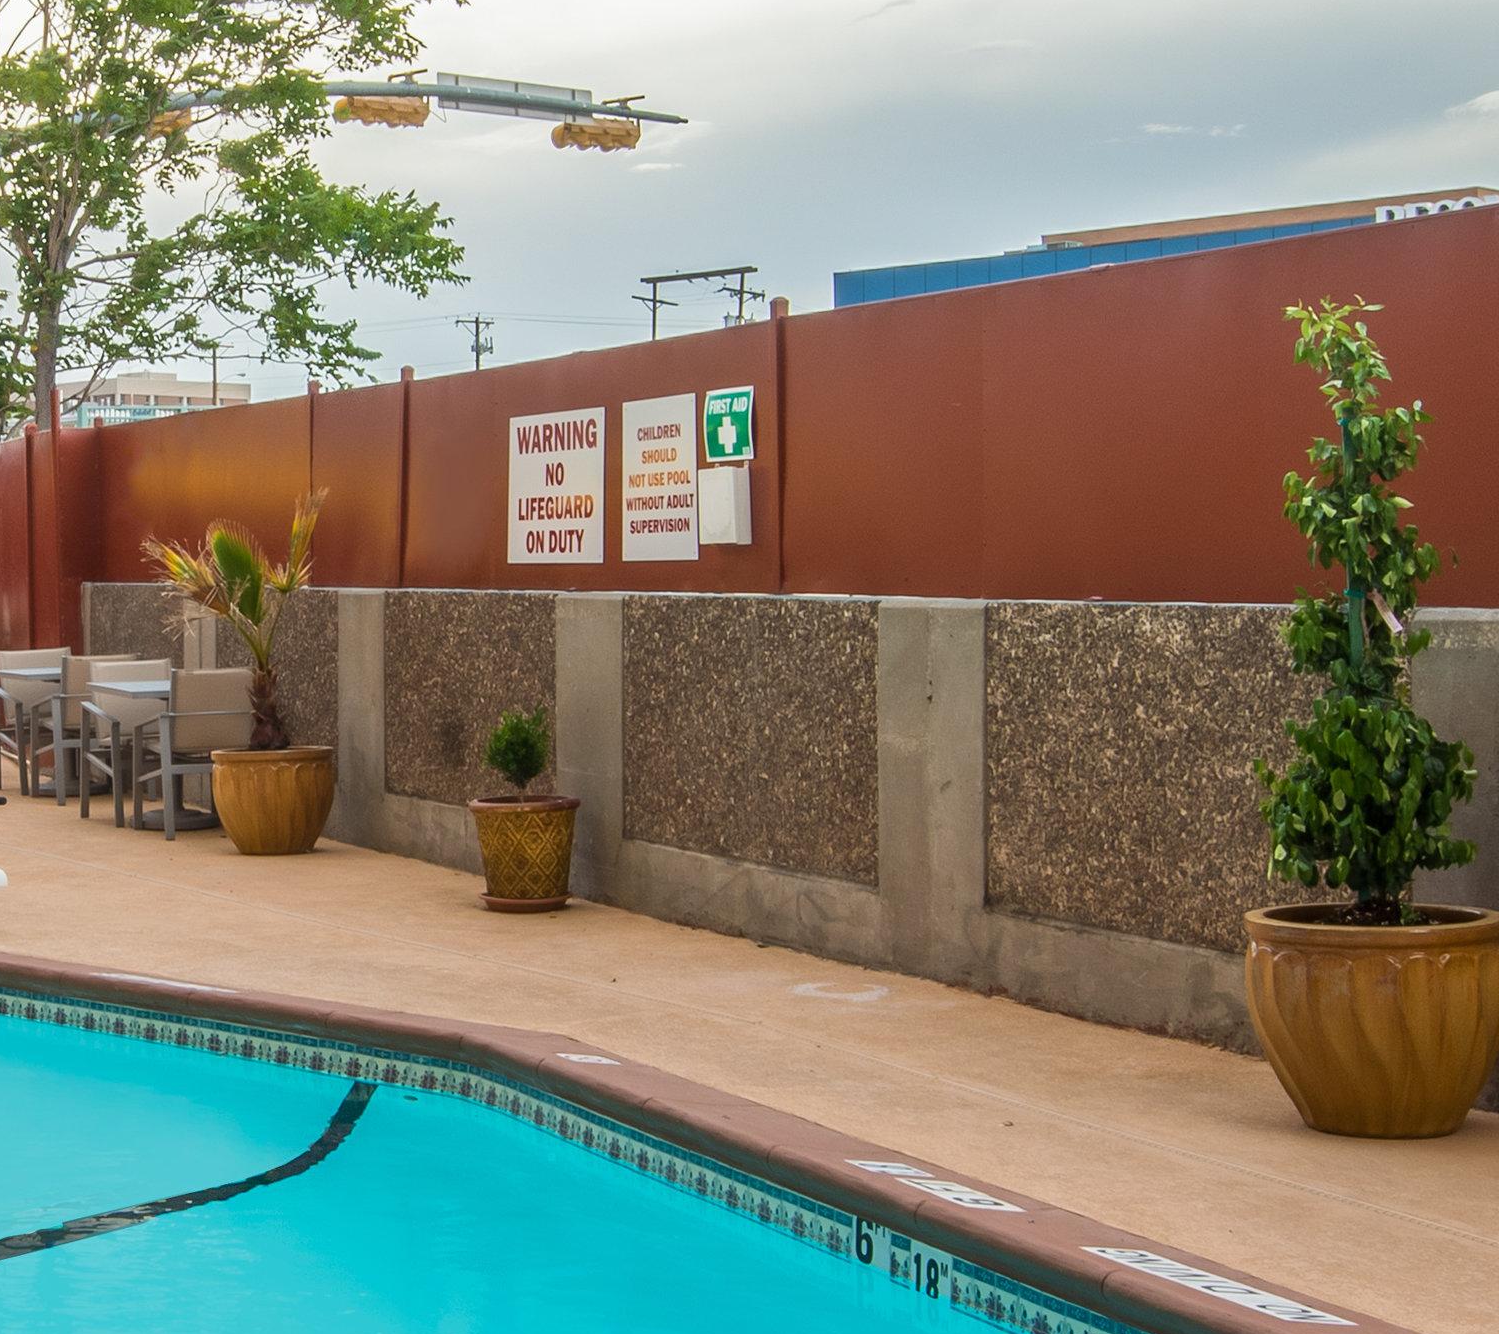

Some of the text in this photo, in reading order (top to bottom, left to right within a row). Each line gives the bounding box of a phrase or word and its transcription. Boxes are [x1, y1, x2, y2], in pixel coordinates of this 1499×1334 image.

[709, 397, 748, 415] FIRST AID
[516, 418, 597, 455] WARNING
[636, 423, 681, 442] CHILDREN
[641, 448, 677, 465] SHOULD
[545, 461, 564, 487] NO
[628, 470, 691, 487] NOT USE POOL
[518, 494, 594, 521] LIFEGUARD
[626, 493, 694, 512] WITHOUT ADULT
[629, 518, 690, 535] SUPERVISION
[526, 528, 584, 554] ON DUTY
[855, 1216, 875, 1264] 6
